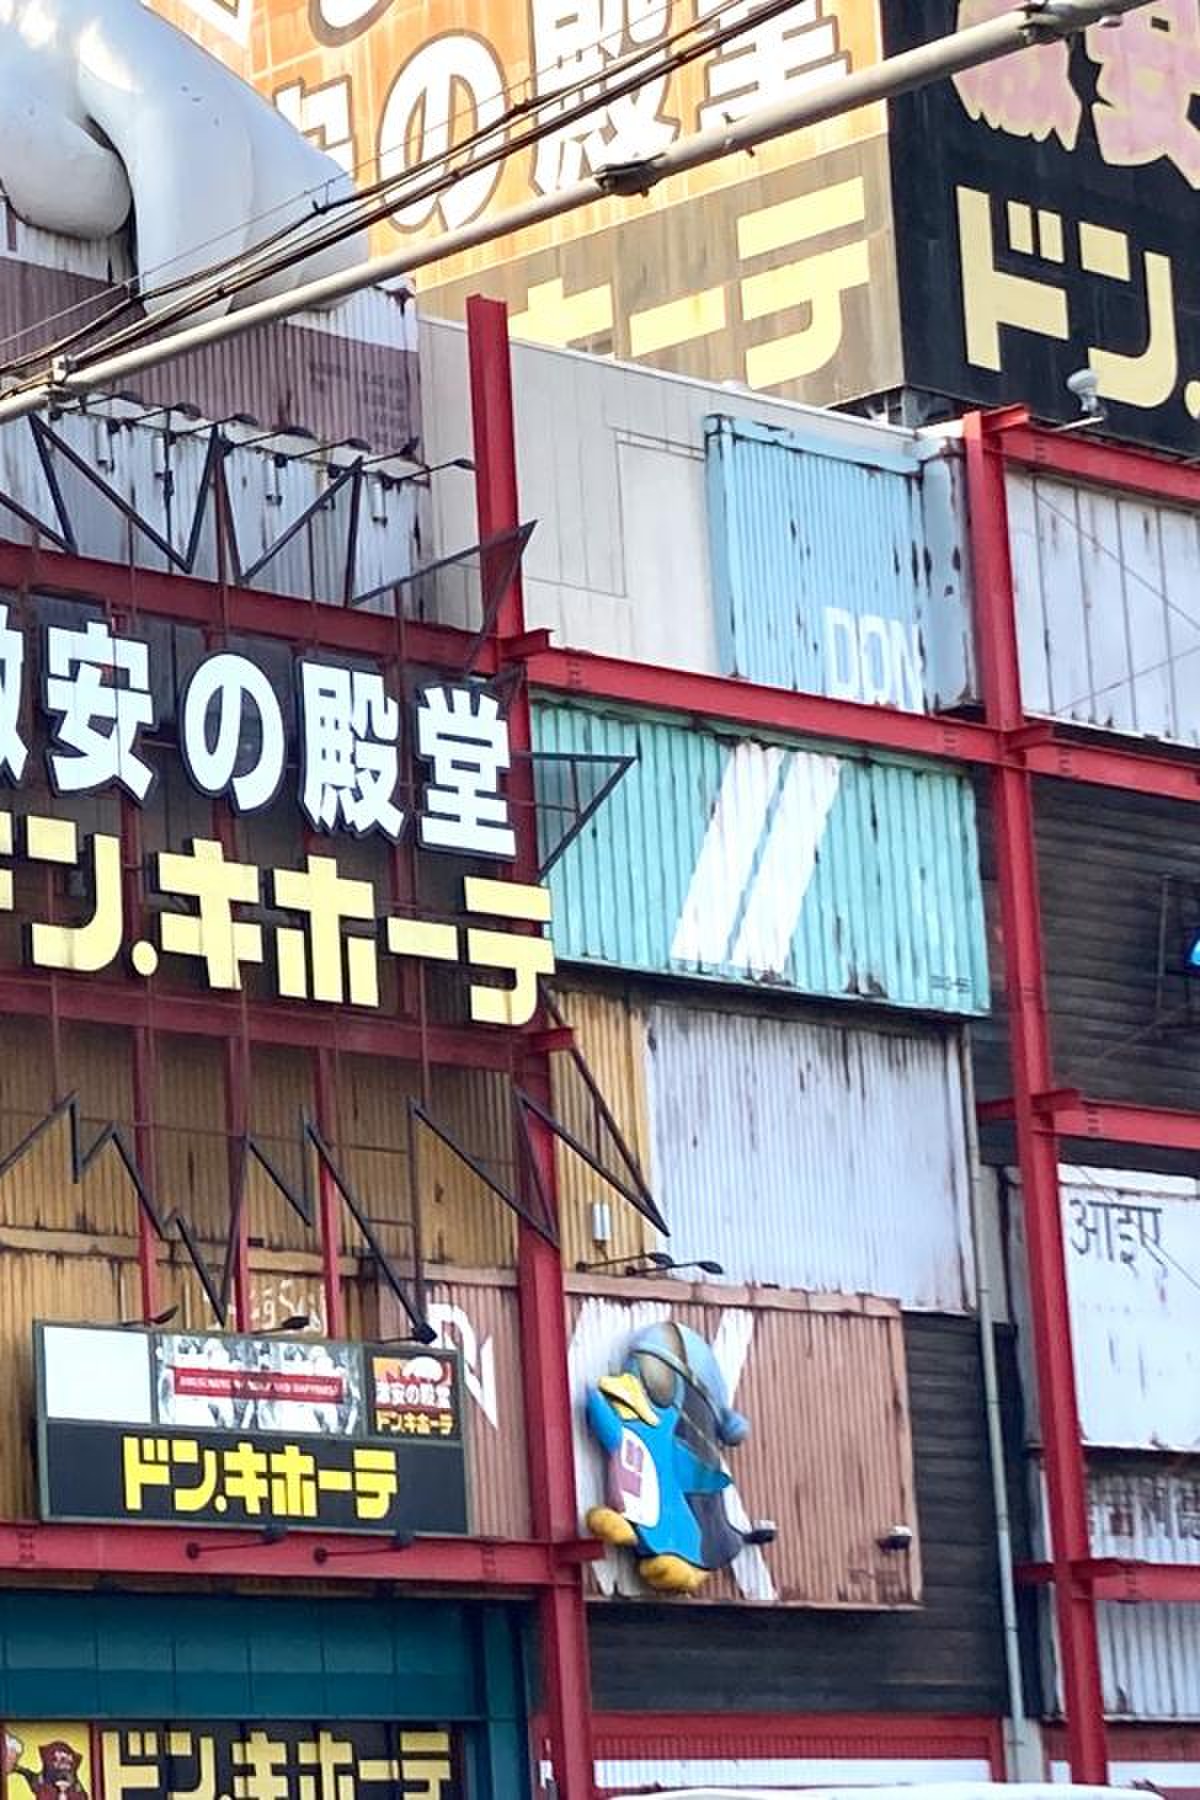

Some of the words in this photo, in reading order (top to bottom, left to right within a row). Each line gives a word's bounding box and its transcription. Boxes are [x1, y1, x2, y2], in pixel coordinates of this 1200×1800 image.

[122, 1436, 398, 1520] ドン.キホーテ
